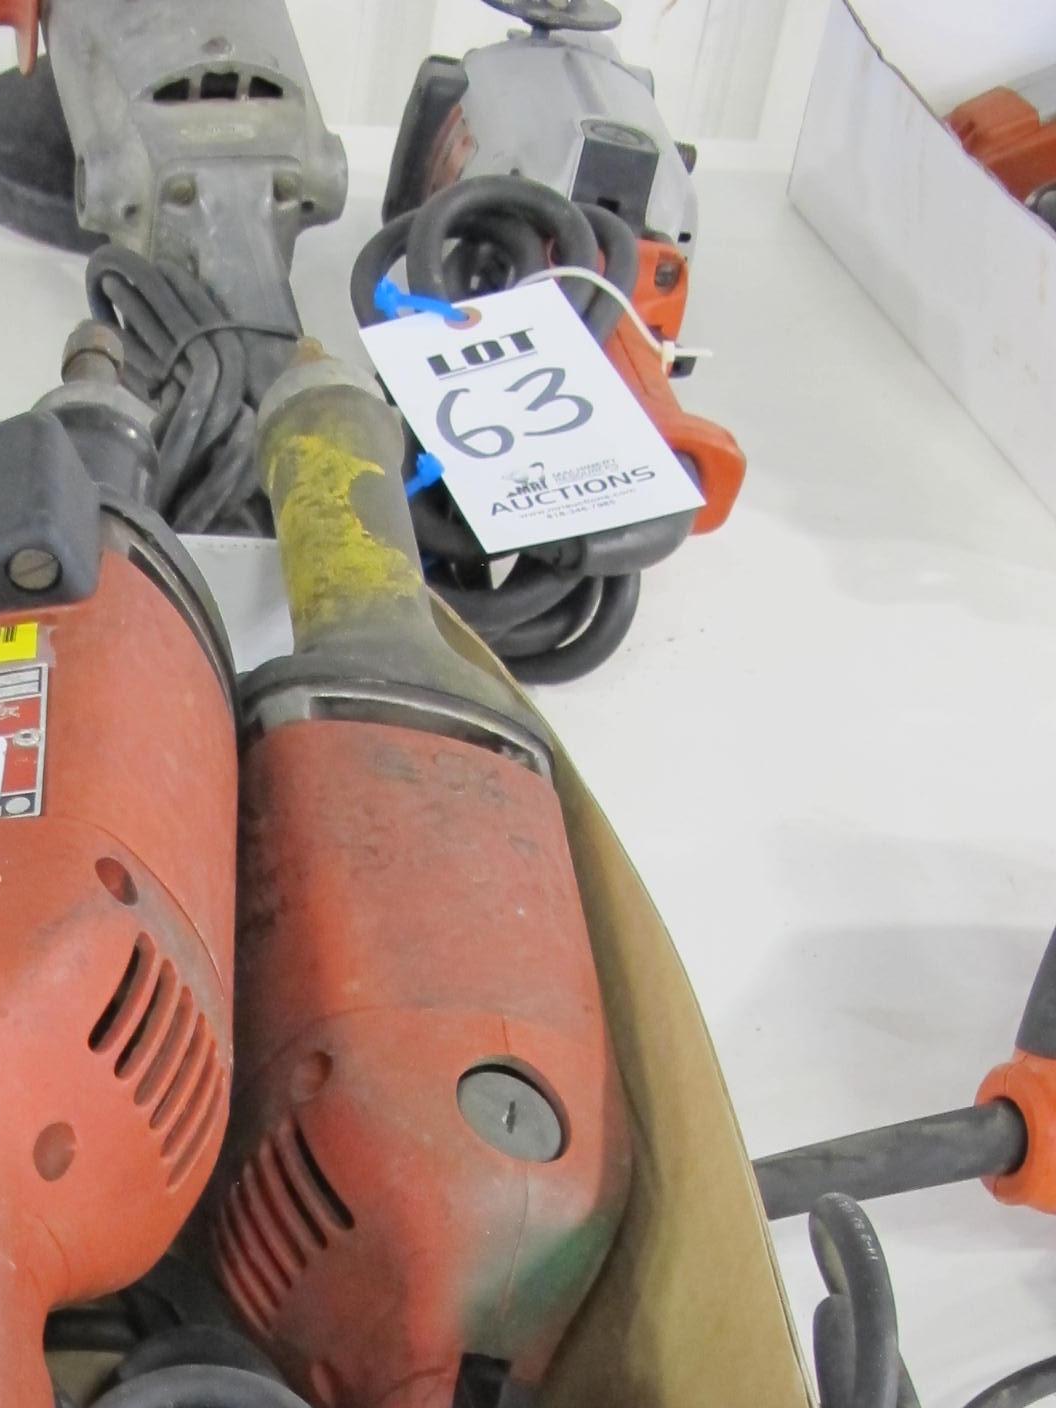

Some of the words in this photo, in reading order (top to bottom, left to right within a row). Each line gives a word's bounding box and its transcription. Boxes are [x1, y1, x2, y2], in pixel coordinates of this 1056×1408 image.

[426, 327, 534, 377] LOT
[436, 366, 594, 460] 63
[491, 465, 656, 517] AUCTIONS
[515, 477, 548, 496] MRI
